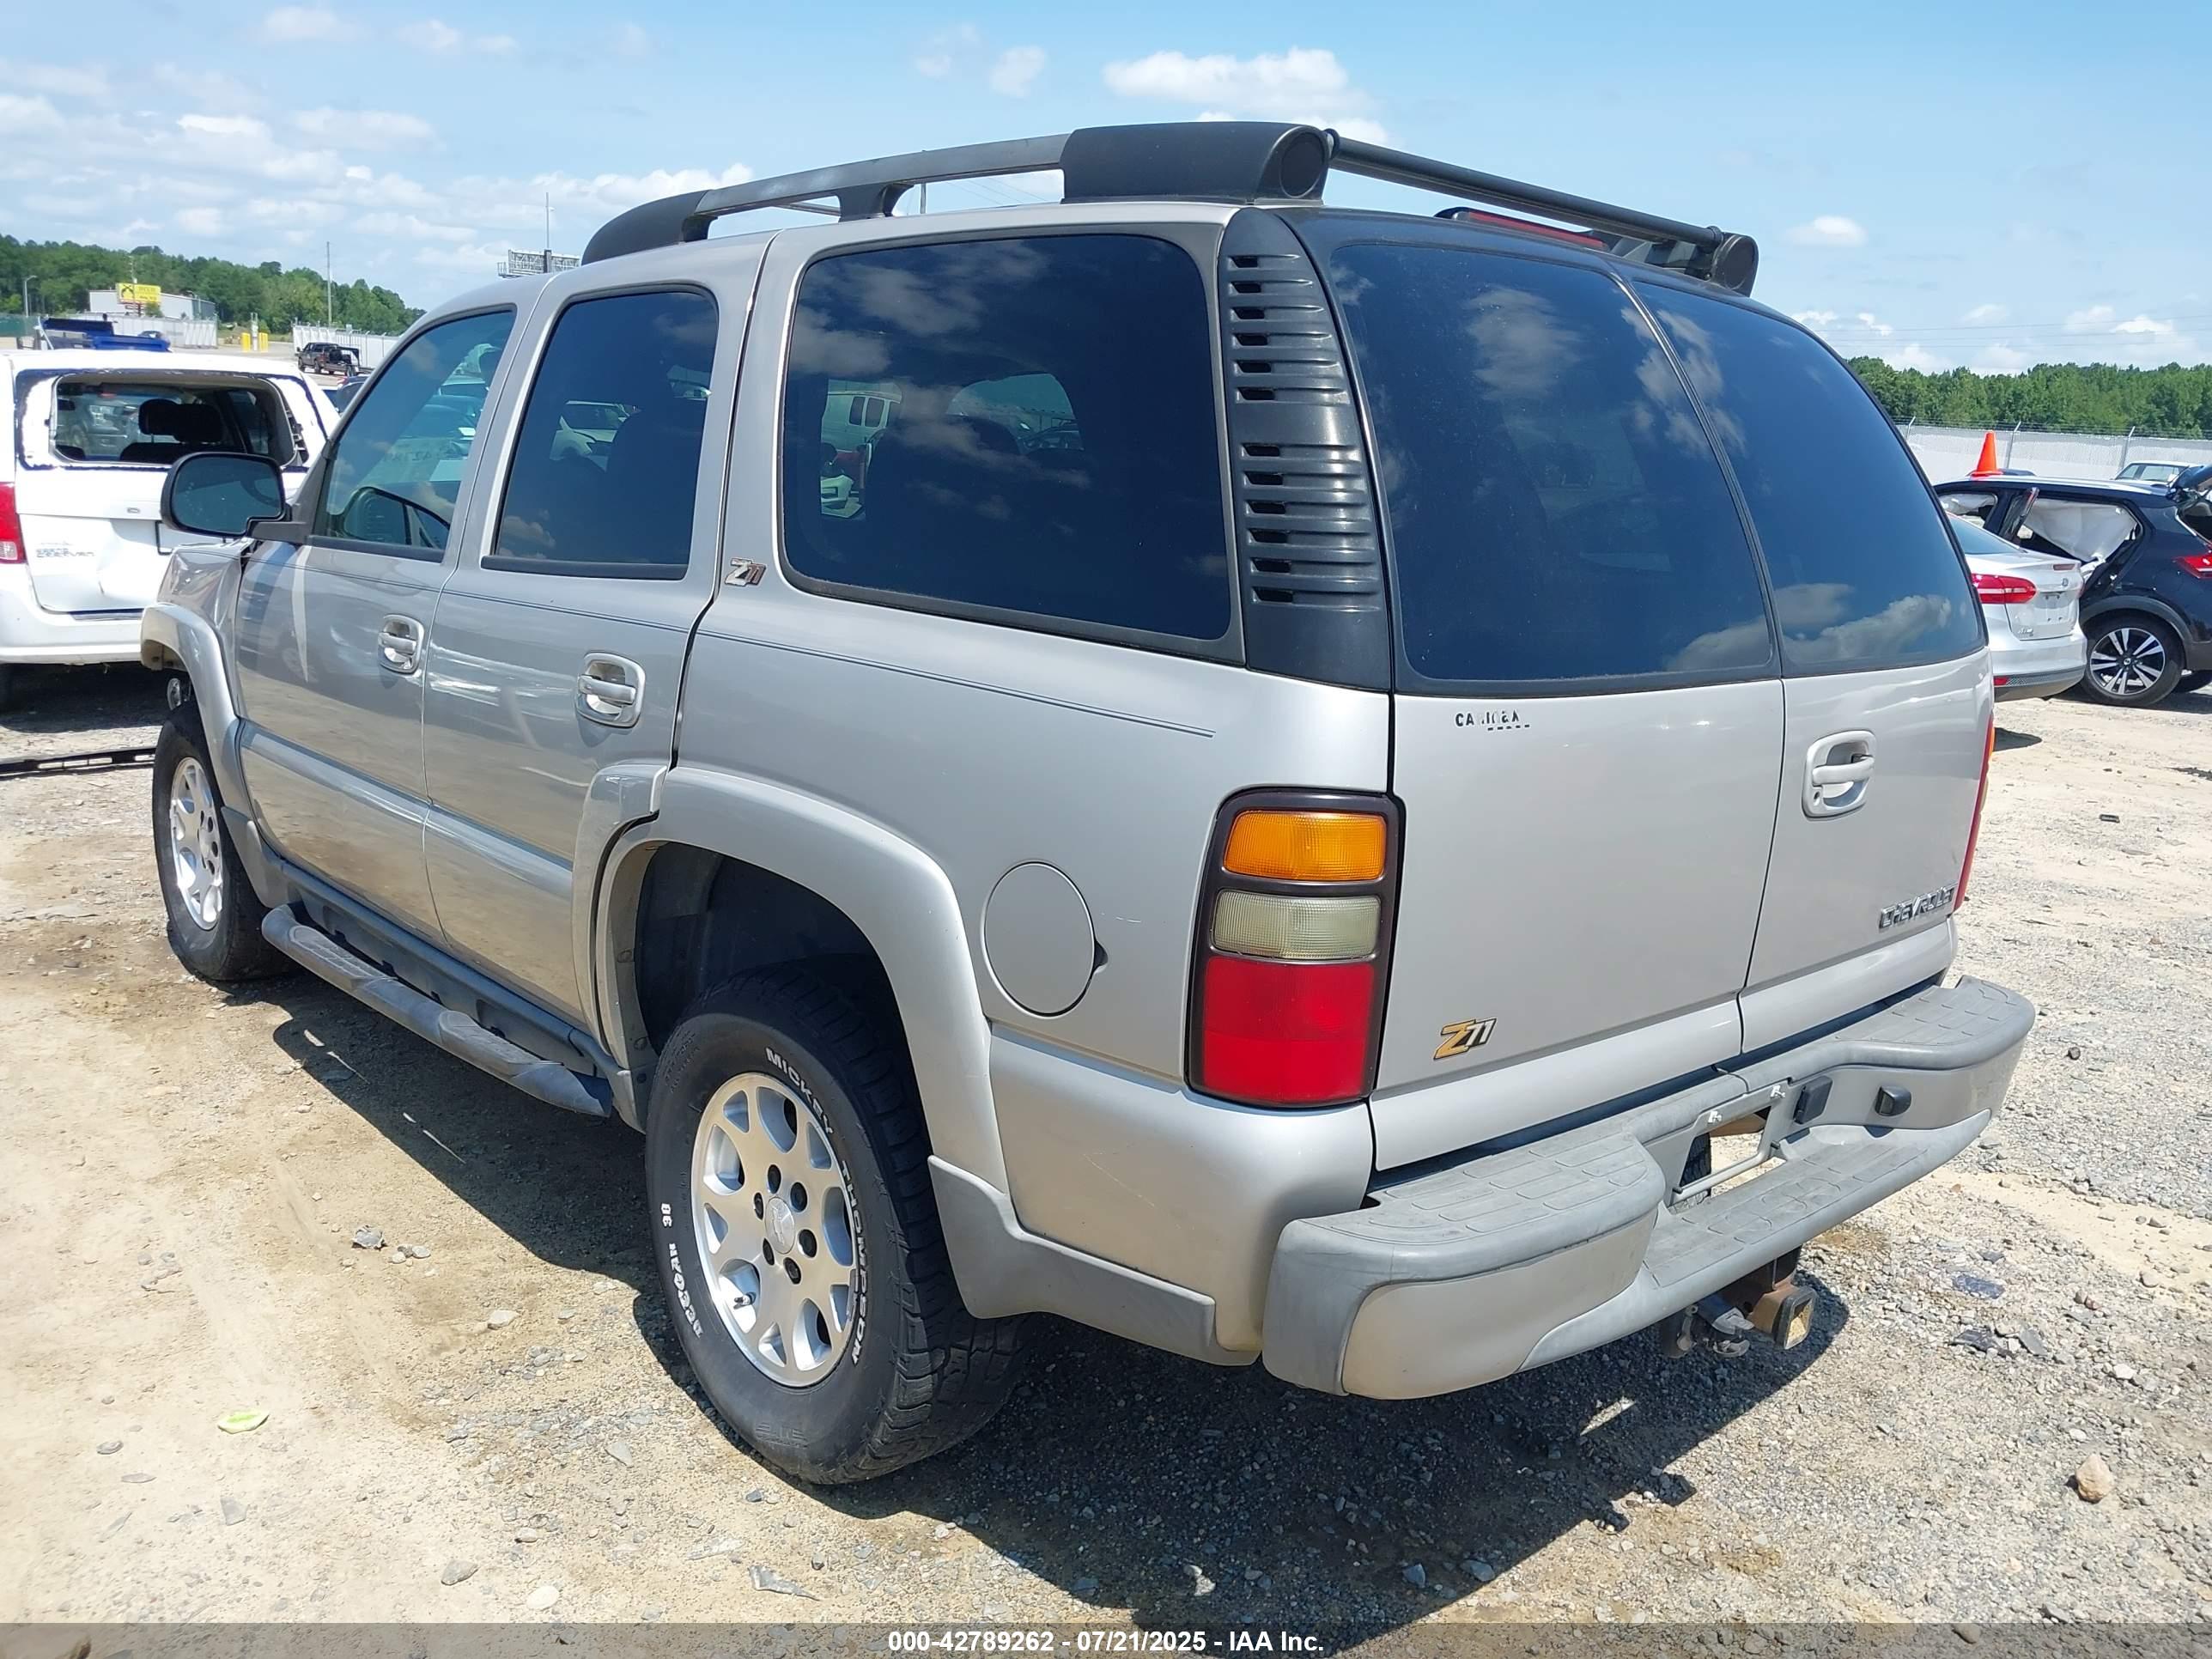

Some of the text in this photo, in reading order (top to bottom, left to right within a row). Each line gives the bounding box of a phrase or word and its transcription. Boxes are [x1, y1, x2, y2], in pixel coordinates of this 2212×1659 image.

[725, 558, 766, 586] Z71
[1879, 884, 1959, 928] CHEVROLET
[1433, 1018, 1497, 1060] Z71
[661, 1203, 672, 1227] 38
[765, 1047, 867, 1364] MICKEY THOMPSON
